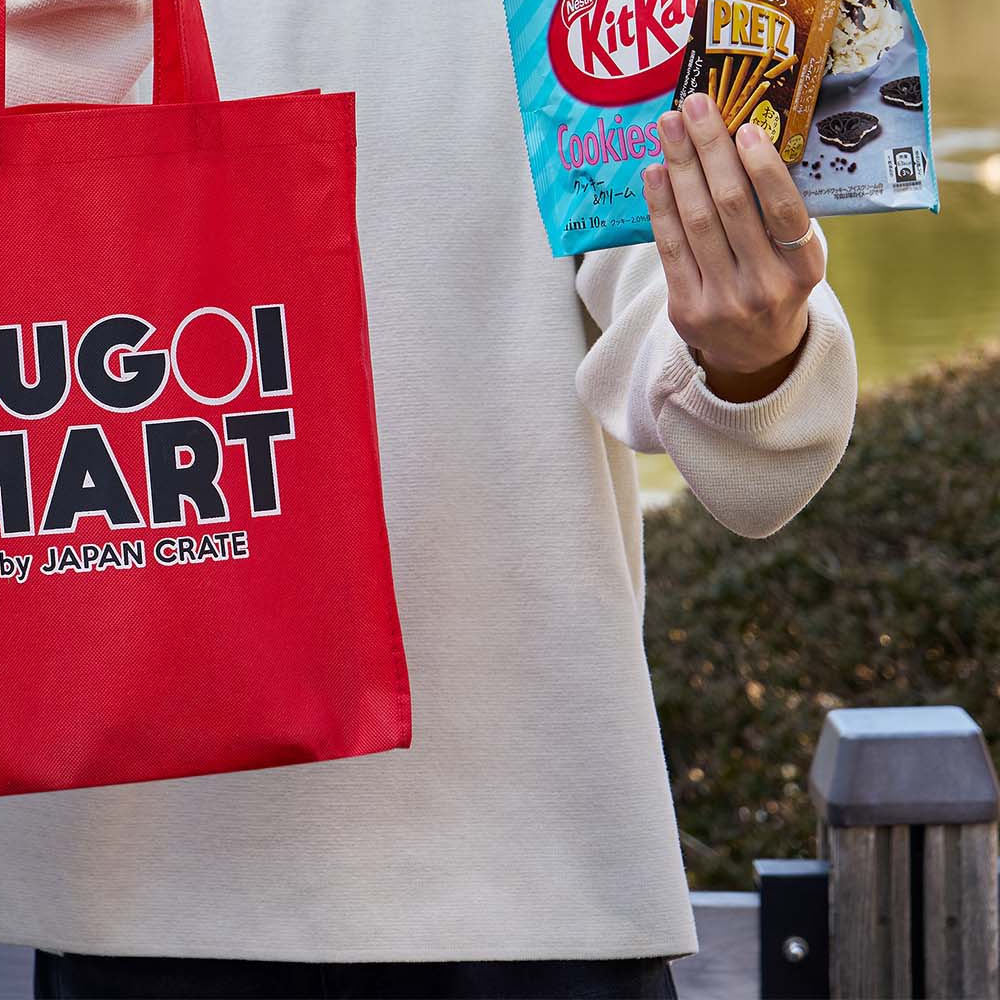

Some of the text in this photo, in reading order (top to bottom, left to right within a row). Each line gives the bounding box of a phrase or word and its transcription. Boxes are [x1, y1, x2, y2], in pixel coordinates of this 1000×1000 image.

[711, 1, 791, 56] PRETZ
[557, 113, 662, 172] Cookies
[573, 178, 605, 195] クッキー
[40, 540, 146, 576] JAPAN
[153, 531, 249, 567] CRATE
